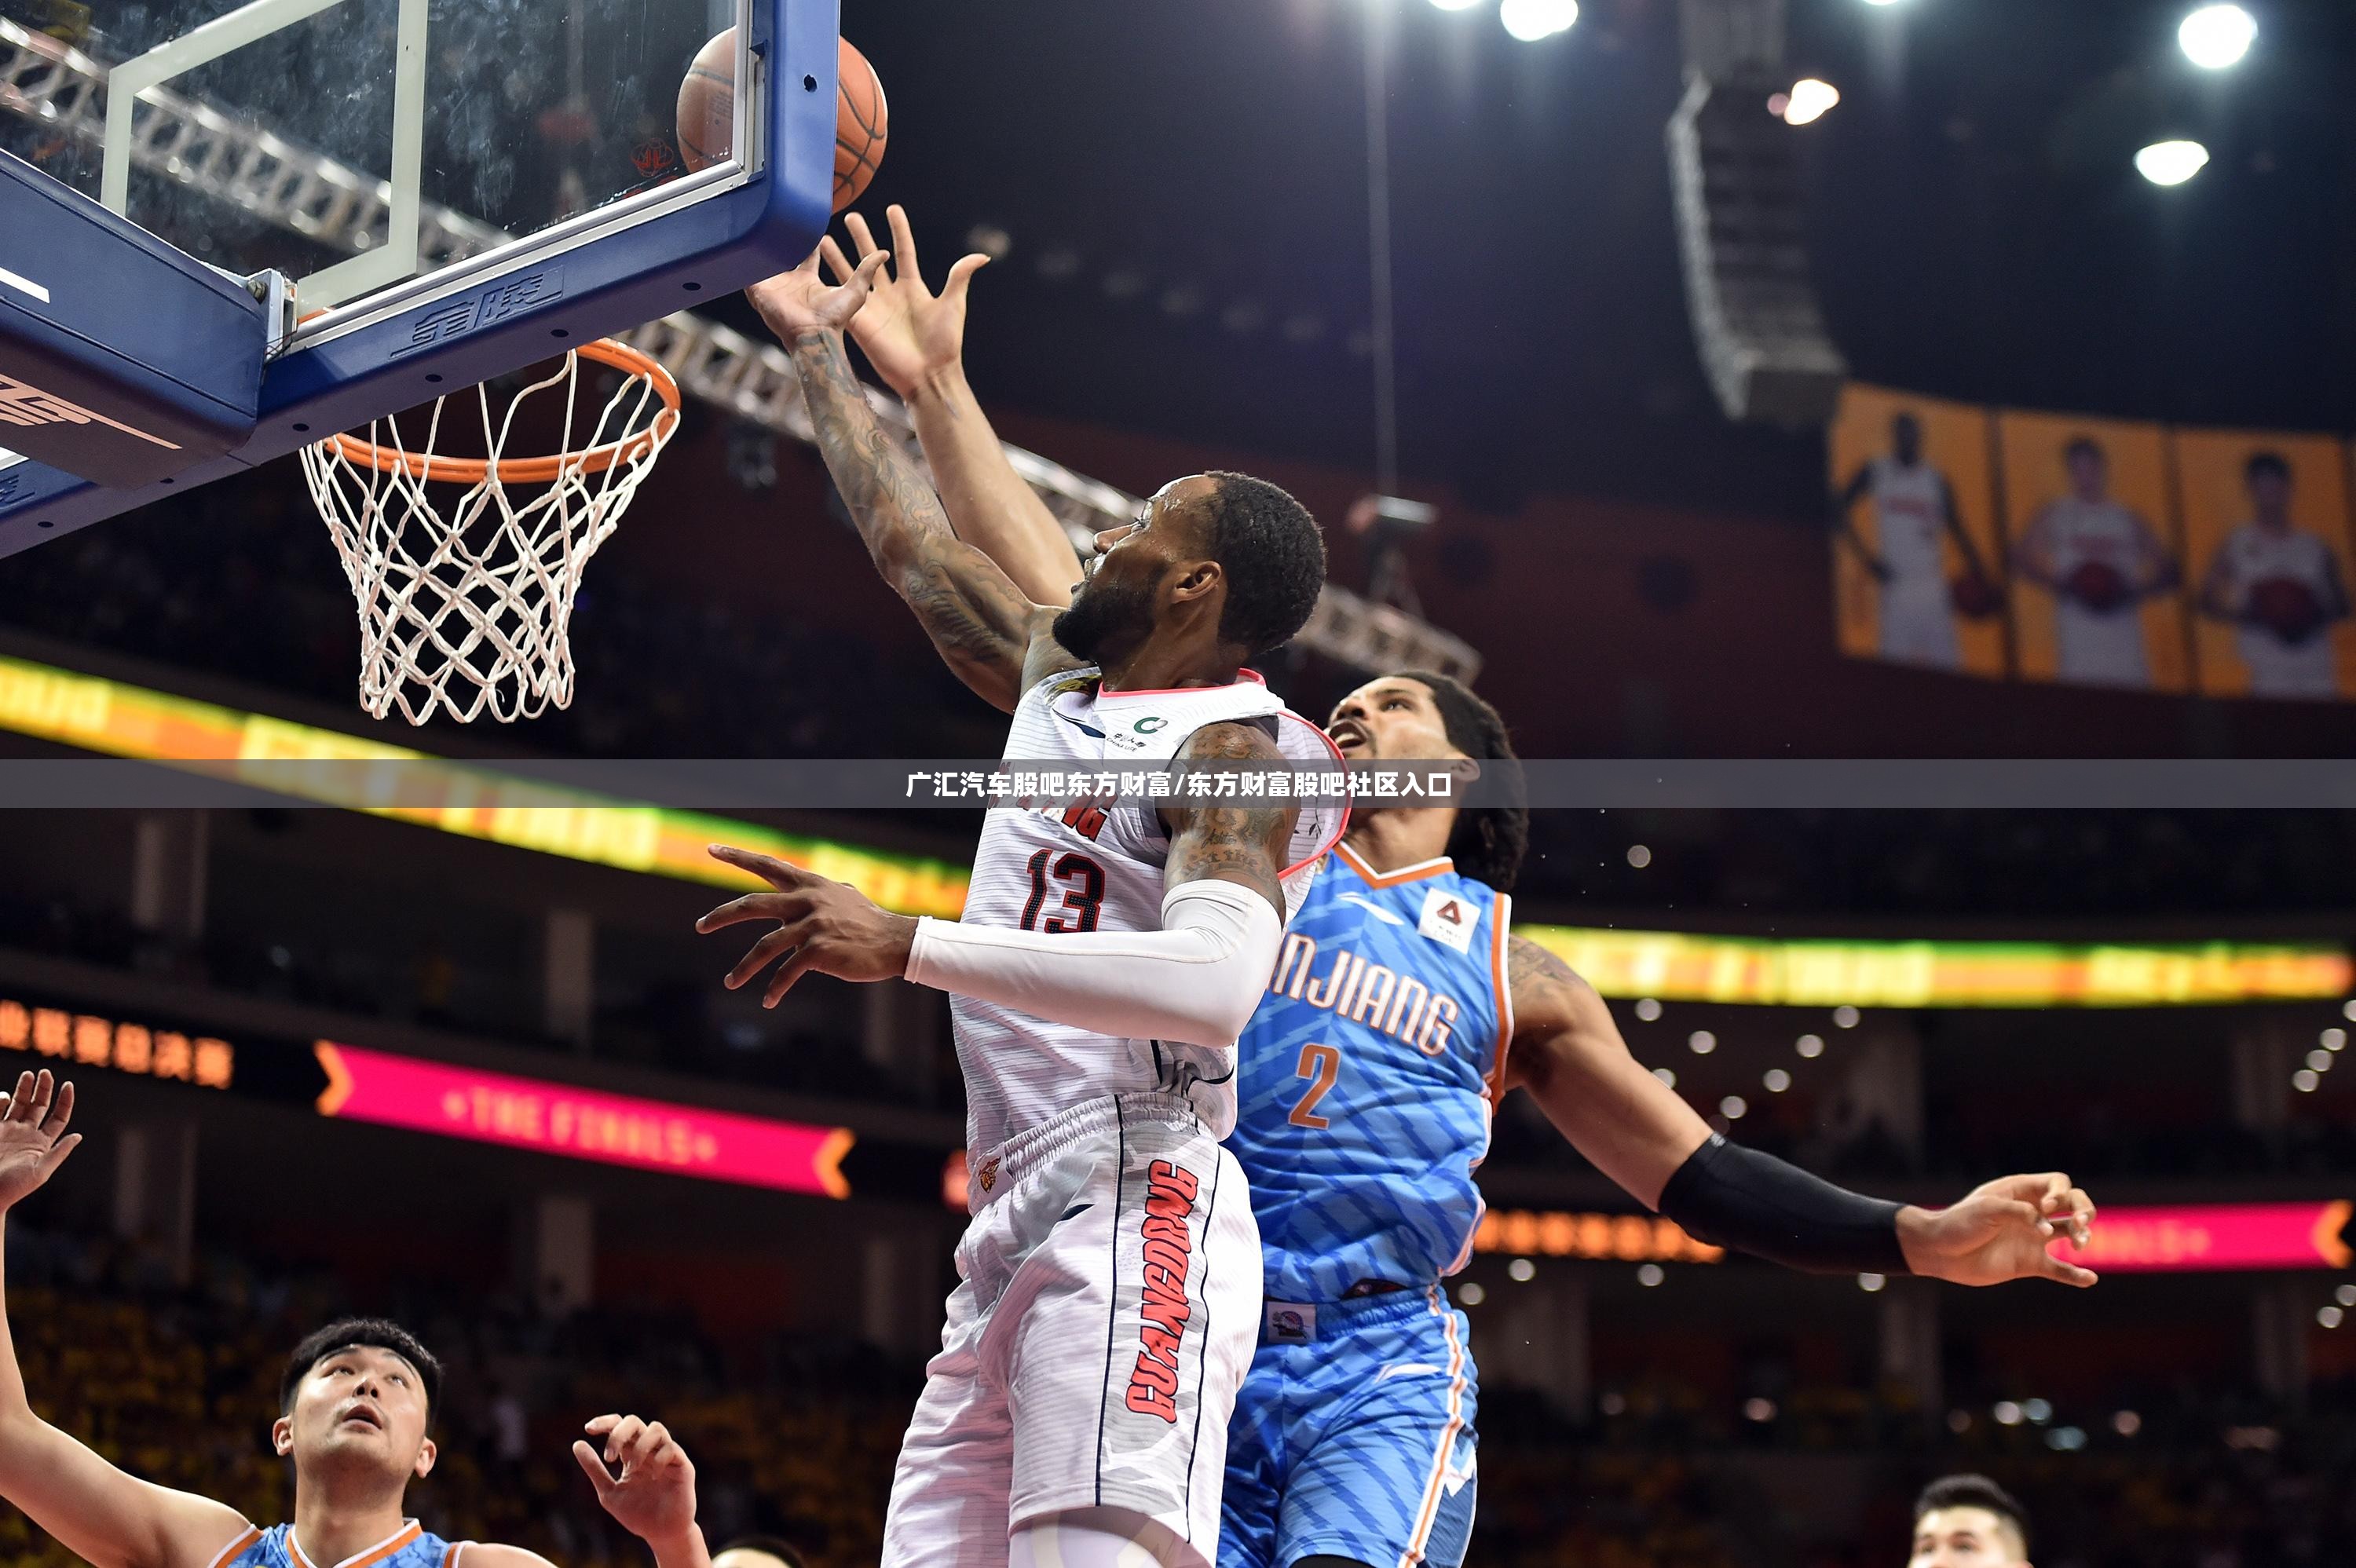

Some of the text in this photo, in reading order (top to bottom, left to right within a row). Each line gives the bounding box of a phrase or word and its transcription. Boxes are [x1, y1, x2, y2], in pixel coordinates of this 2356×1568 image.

[1020, 849, 1105, 934] 13
[1267, 931, 1459, 1057] NJIANG
[1289, 1043, 1341, 1130] 2
[1126, 1159, 1198, 1424] GUANGDONG
